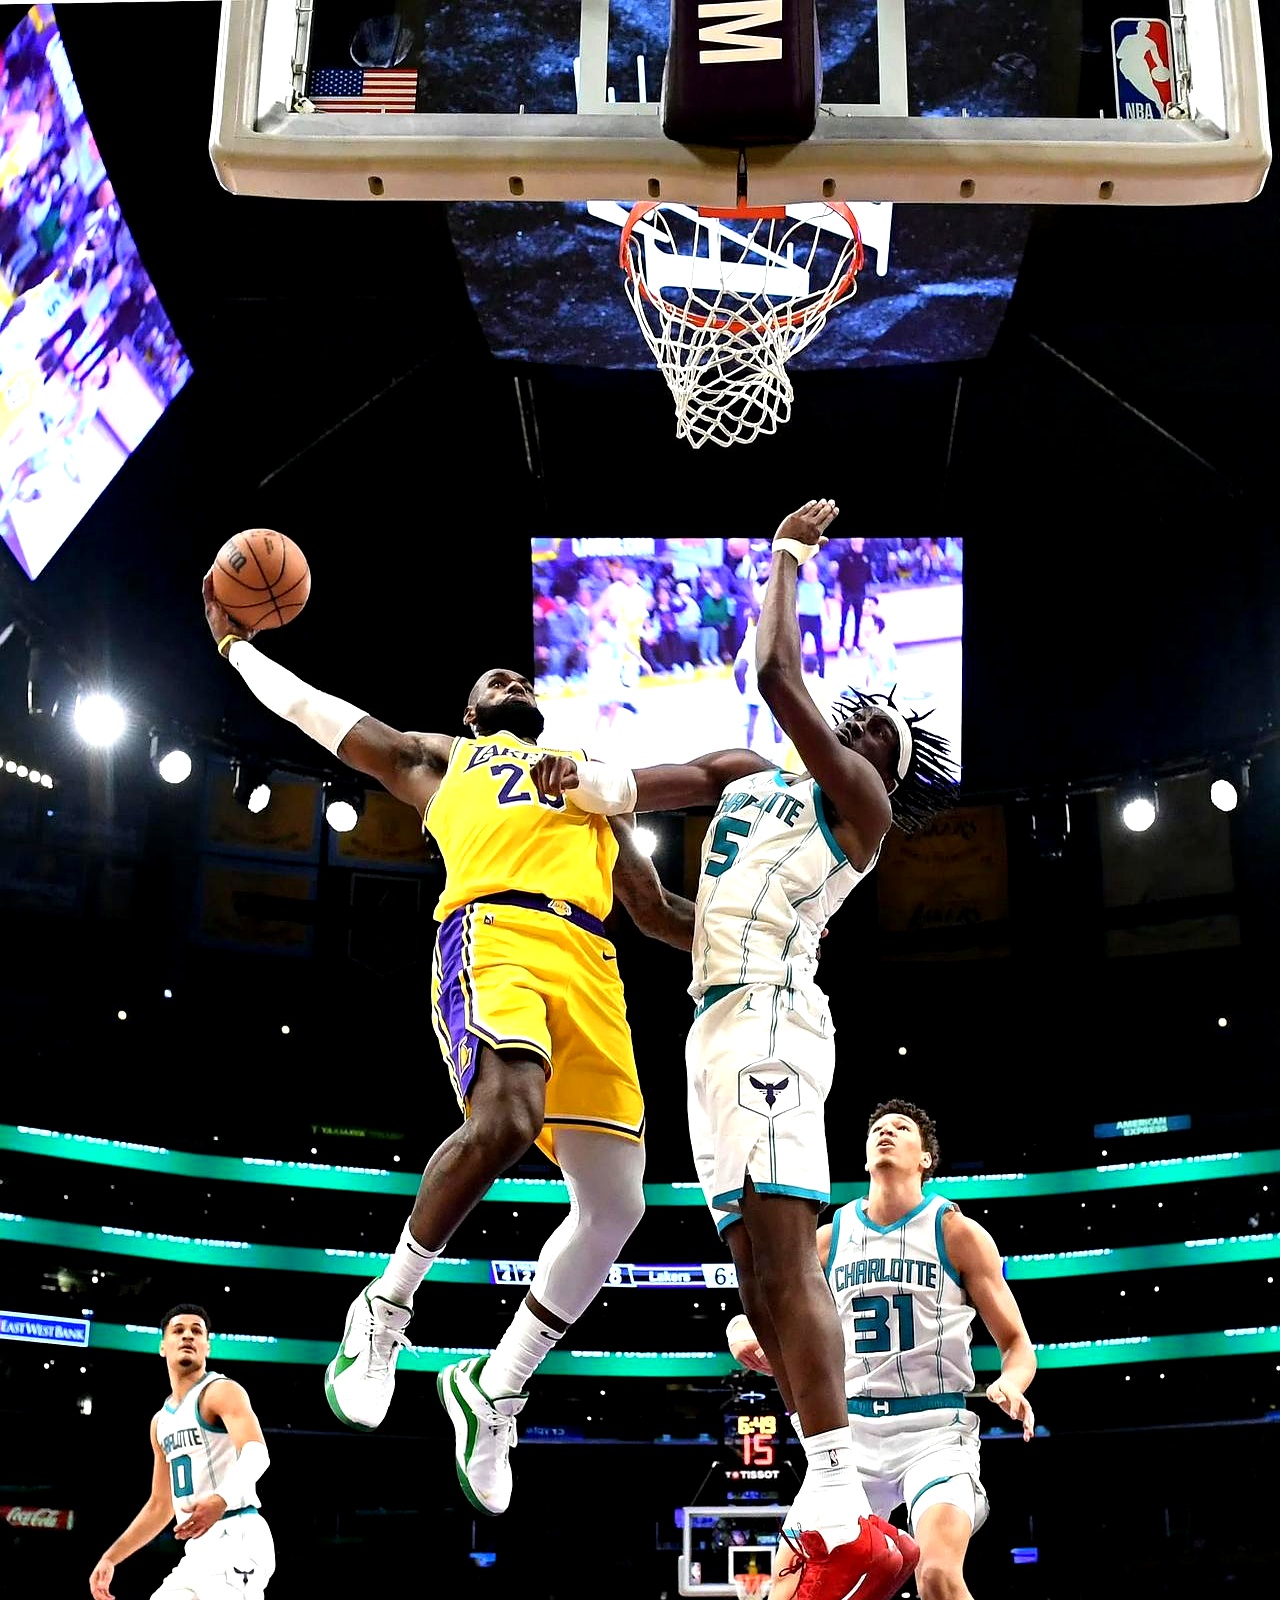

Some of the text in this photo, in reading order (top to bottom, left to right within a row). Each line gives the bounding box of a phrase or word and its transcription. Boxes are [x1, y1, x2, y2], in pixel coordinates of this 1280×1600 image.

[1125, 102, 1154, 119] NBA
[463, 744, 545, 773] LAKE
[704, 815, 751, 877] 5
[1116, 1116, 1167, 1130] AMERICAN
[1123, 1126, 1168, 1137] EXPRESS
[648, 1269, 691, 1283] Lakers
[714, 1267, 734, 1286] 6:
[834, 1258, 937, 1293] CHARLOTTE
[851, 1293, 915, 1354] 31
[737, 1415, 777, 1435] 6:49
[161, 1427, 203, 1456] ARLOTTE
[743, 1434, 773, 1466] 15
[171, 1454, 194, 1498] 0
[740, 1470, 780, 1479] TISSOT
